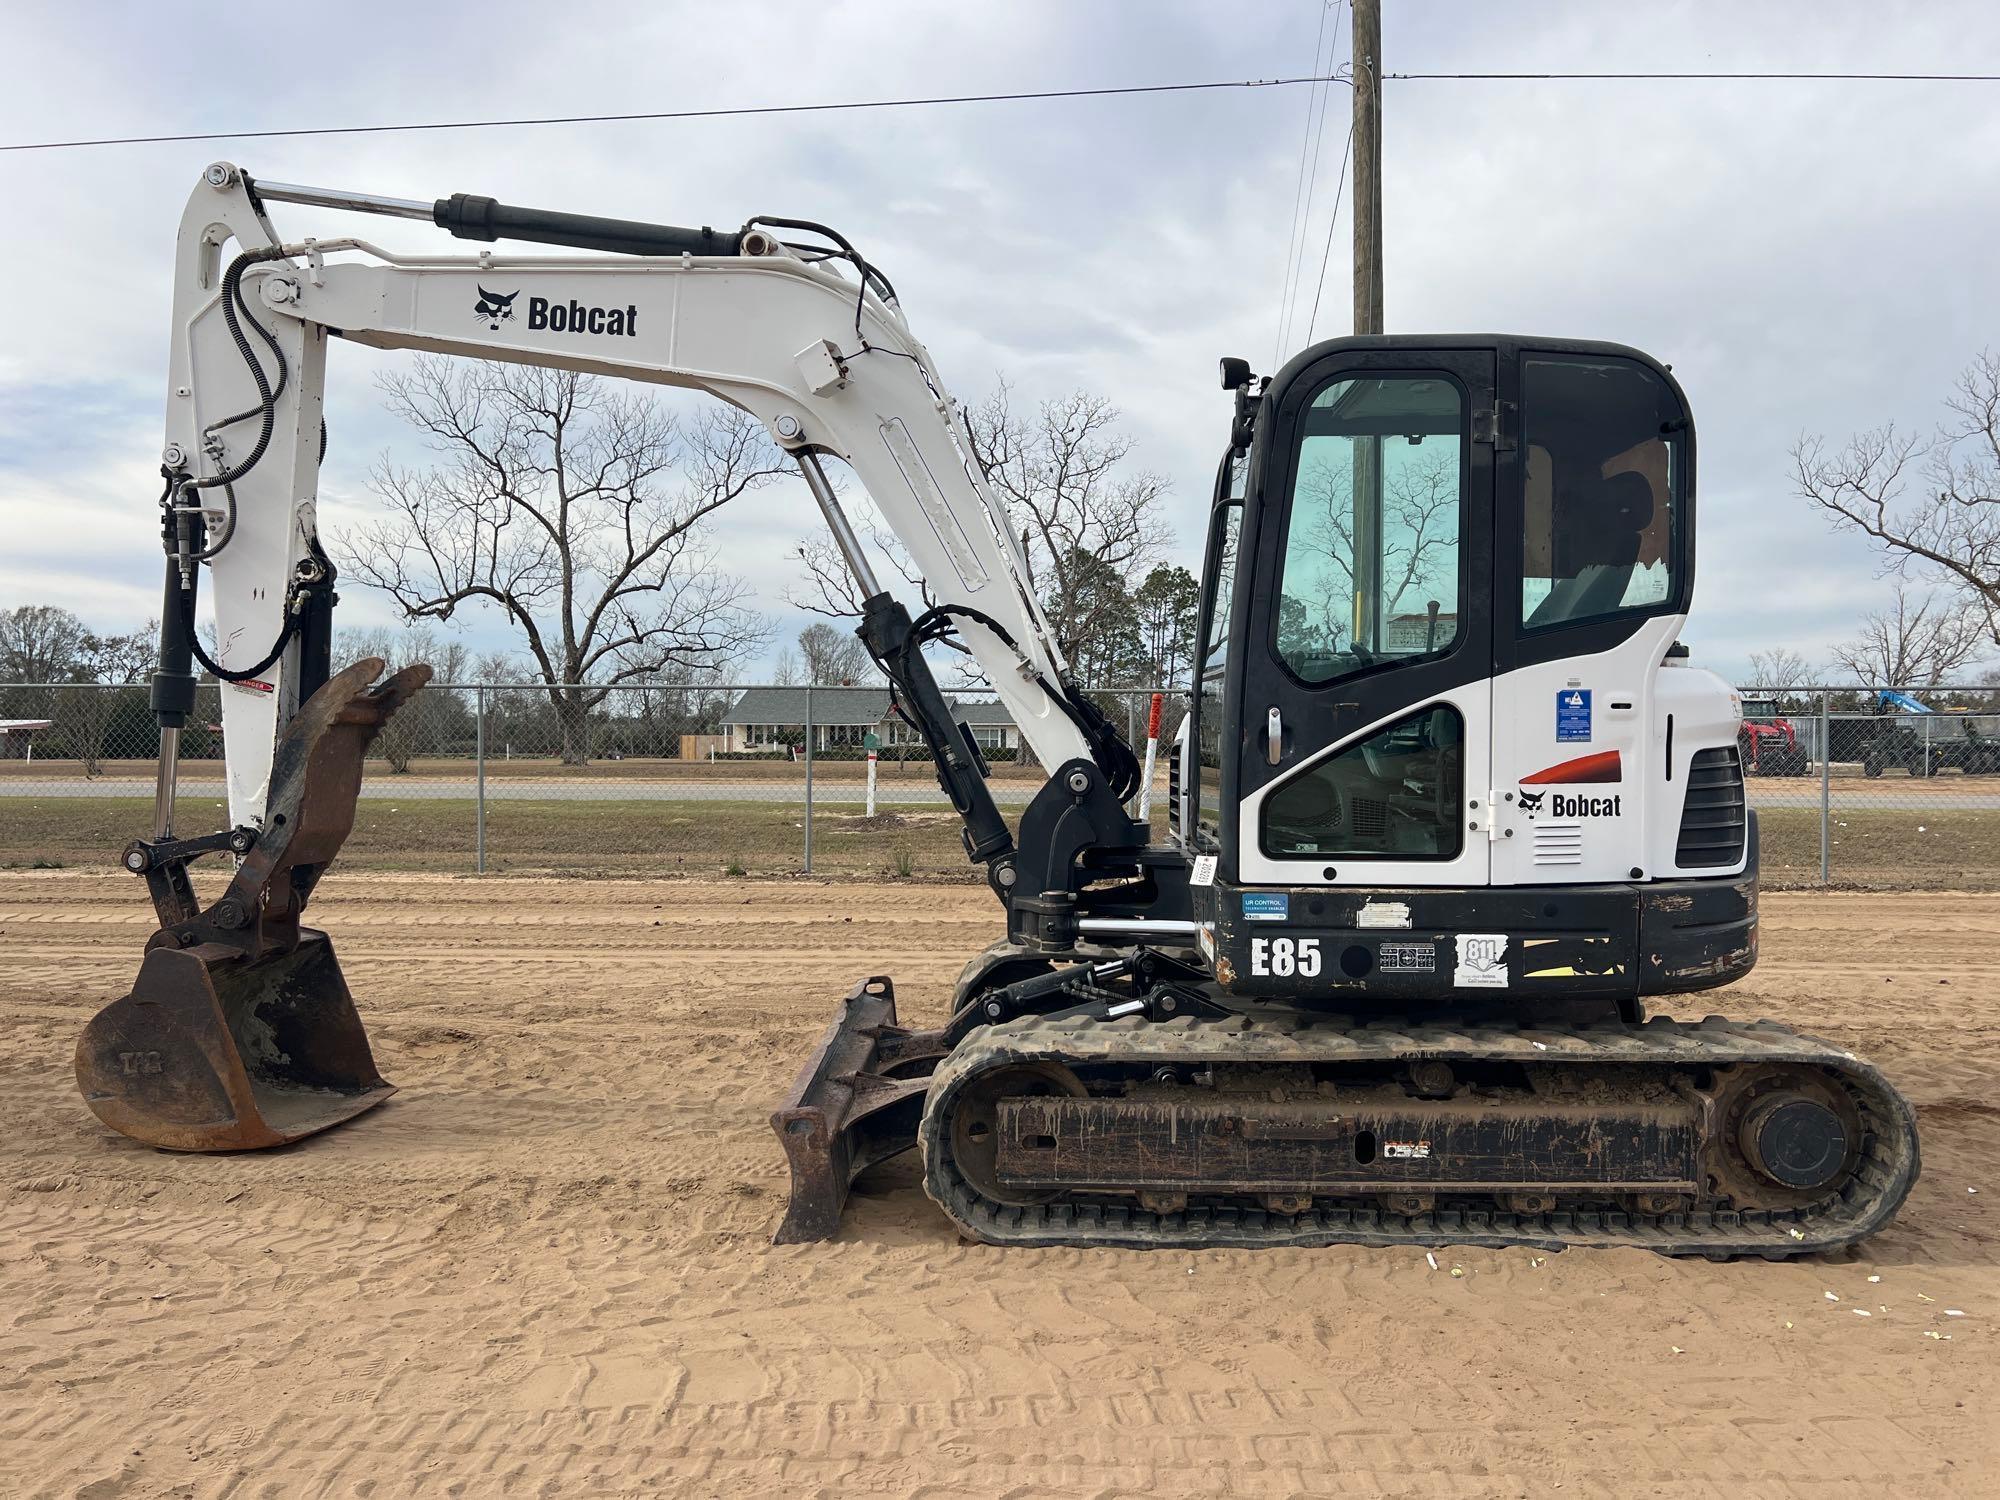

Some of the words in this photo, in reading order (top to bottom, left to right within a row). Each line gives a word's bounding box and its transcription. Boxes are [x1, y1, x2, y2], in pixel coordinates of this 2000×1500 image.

[528, 297, 637, 337] Bobcat
[1552, 794, 1621, 817] Bobcat
[1251, 938, 1321, 977] E85
[1466, 939, 1496, 960] 811
